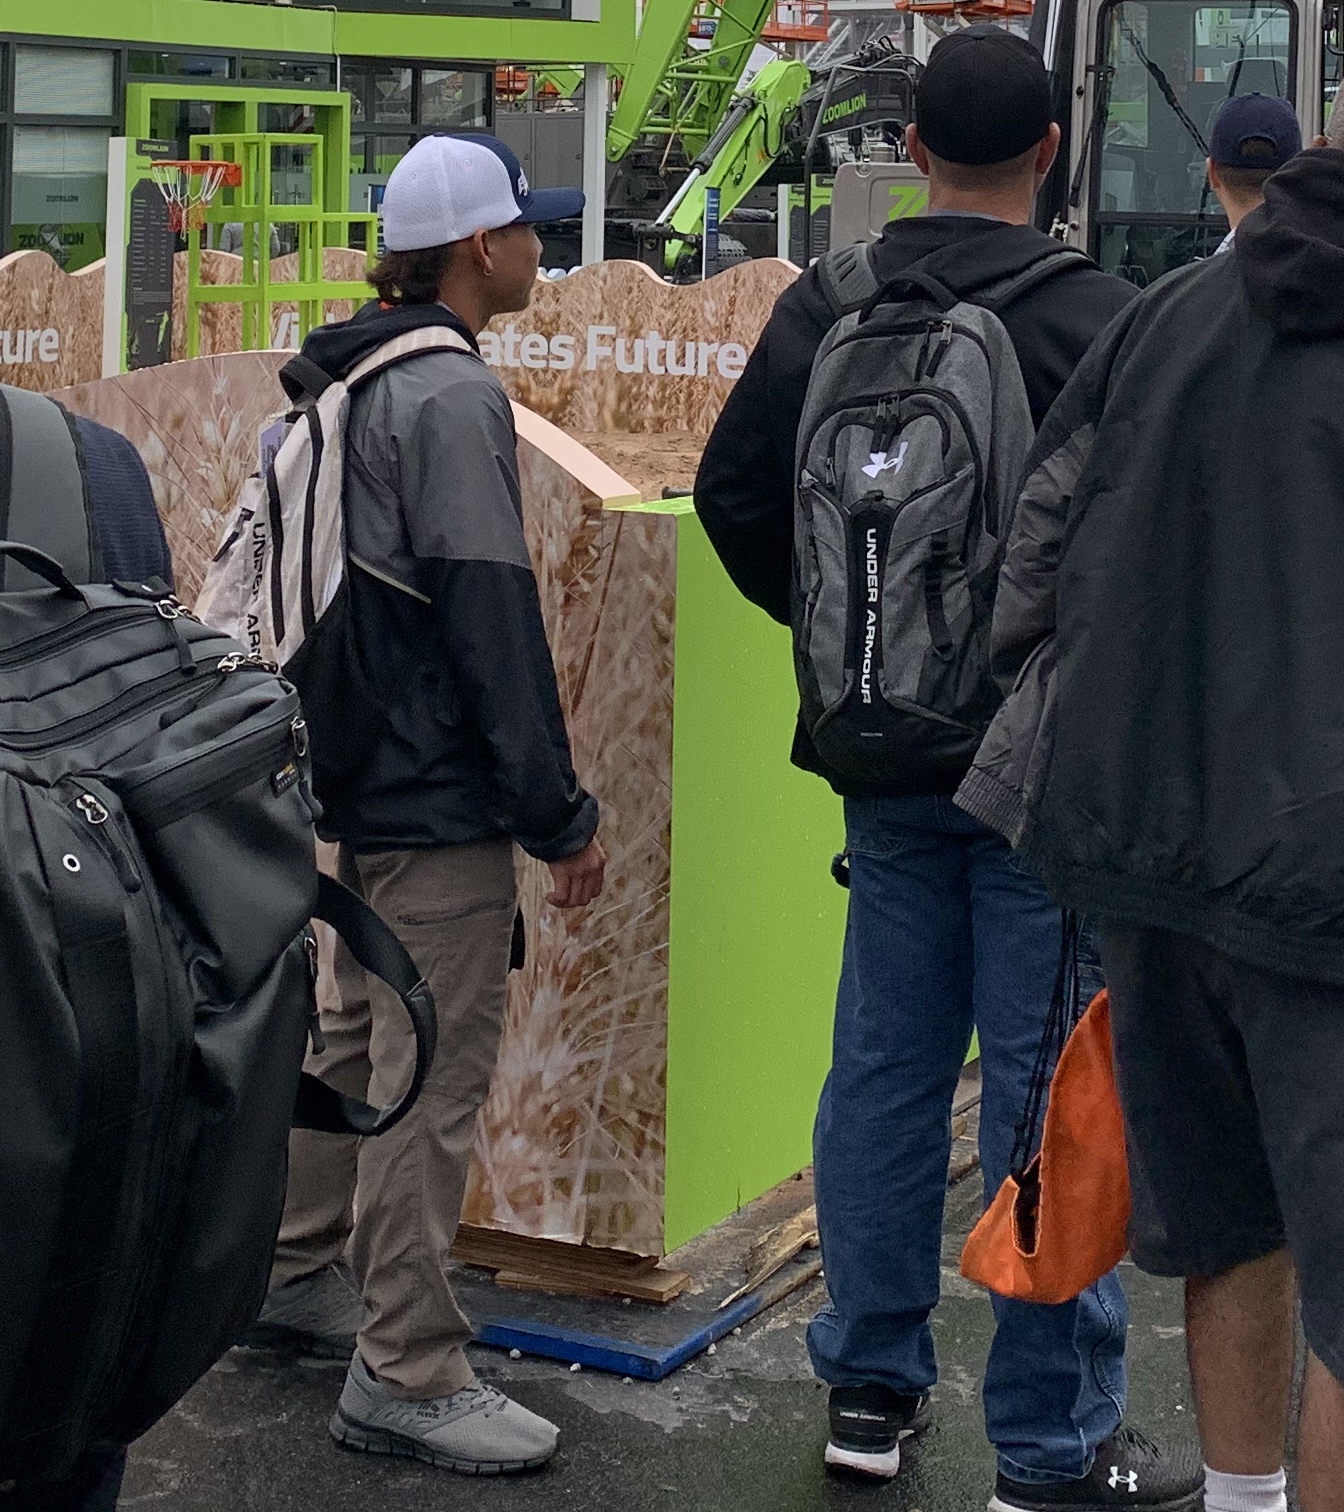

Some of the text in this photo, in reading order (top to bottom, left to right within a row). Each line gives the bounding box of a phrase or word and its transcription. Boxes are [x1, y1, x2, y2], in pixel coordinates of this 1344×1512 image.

[822, 93, 867, 125] ZOOMLION
[18, 232, 84, 248] ZOOION
[478, 322, 747, 379] ates Future
[860, 528, 879, 705] UNDER ARMOUR
